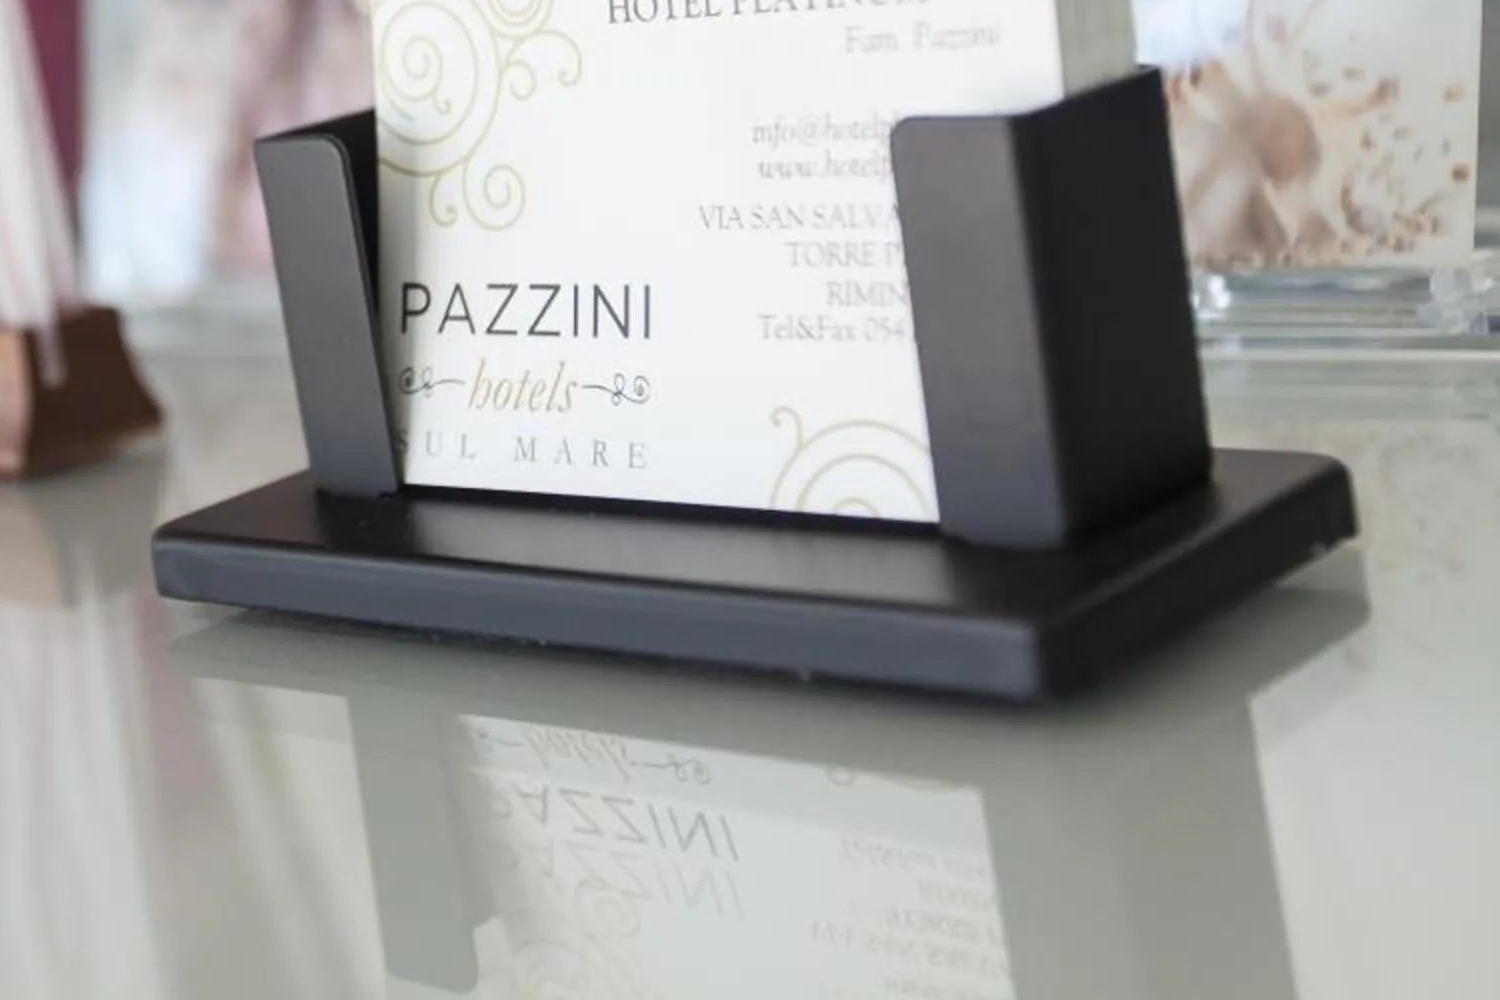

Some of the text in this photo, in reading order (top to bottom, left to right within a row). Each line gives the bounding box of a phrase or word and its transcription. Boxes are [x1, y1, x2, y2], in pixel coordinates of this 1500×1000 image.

[697, 204, 746, 232] VIA
[750, 203, 806, 231] SAN
[785, 240, 879, 268] TORRE
[400, 281, 652, 339] PAZZINI
[757, 311, 857, 344] Tel&Fax
[467, 357, 580, 414] hotels
[512, 434, 650, 470] MARE
